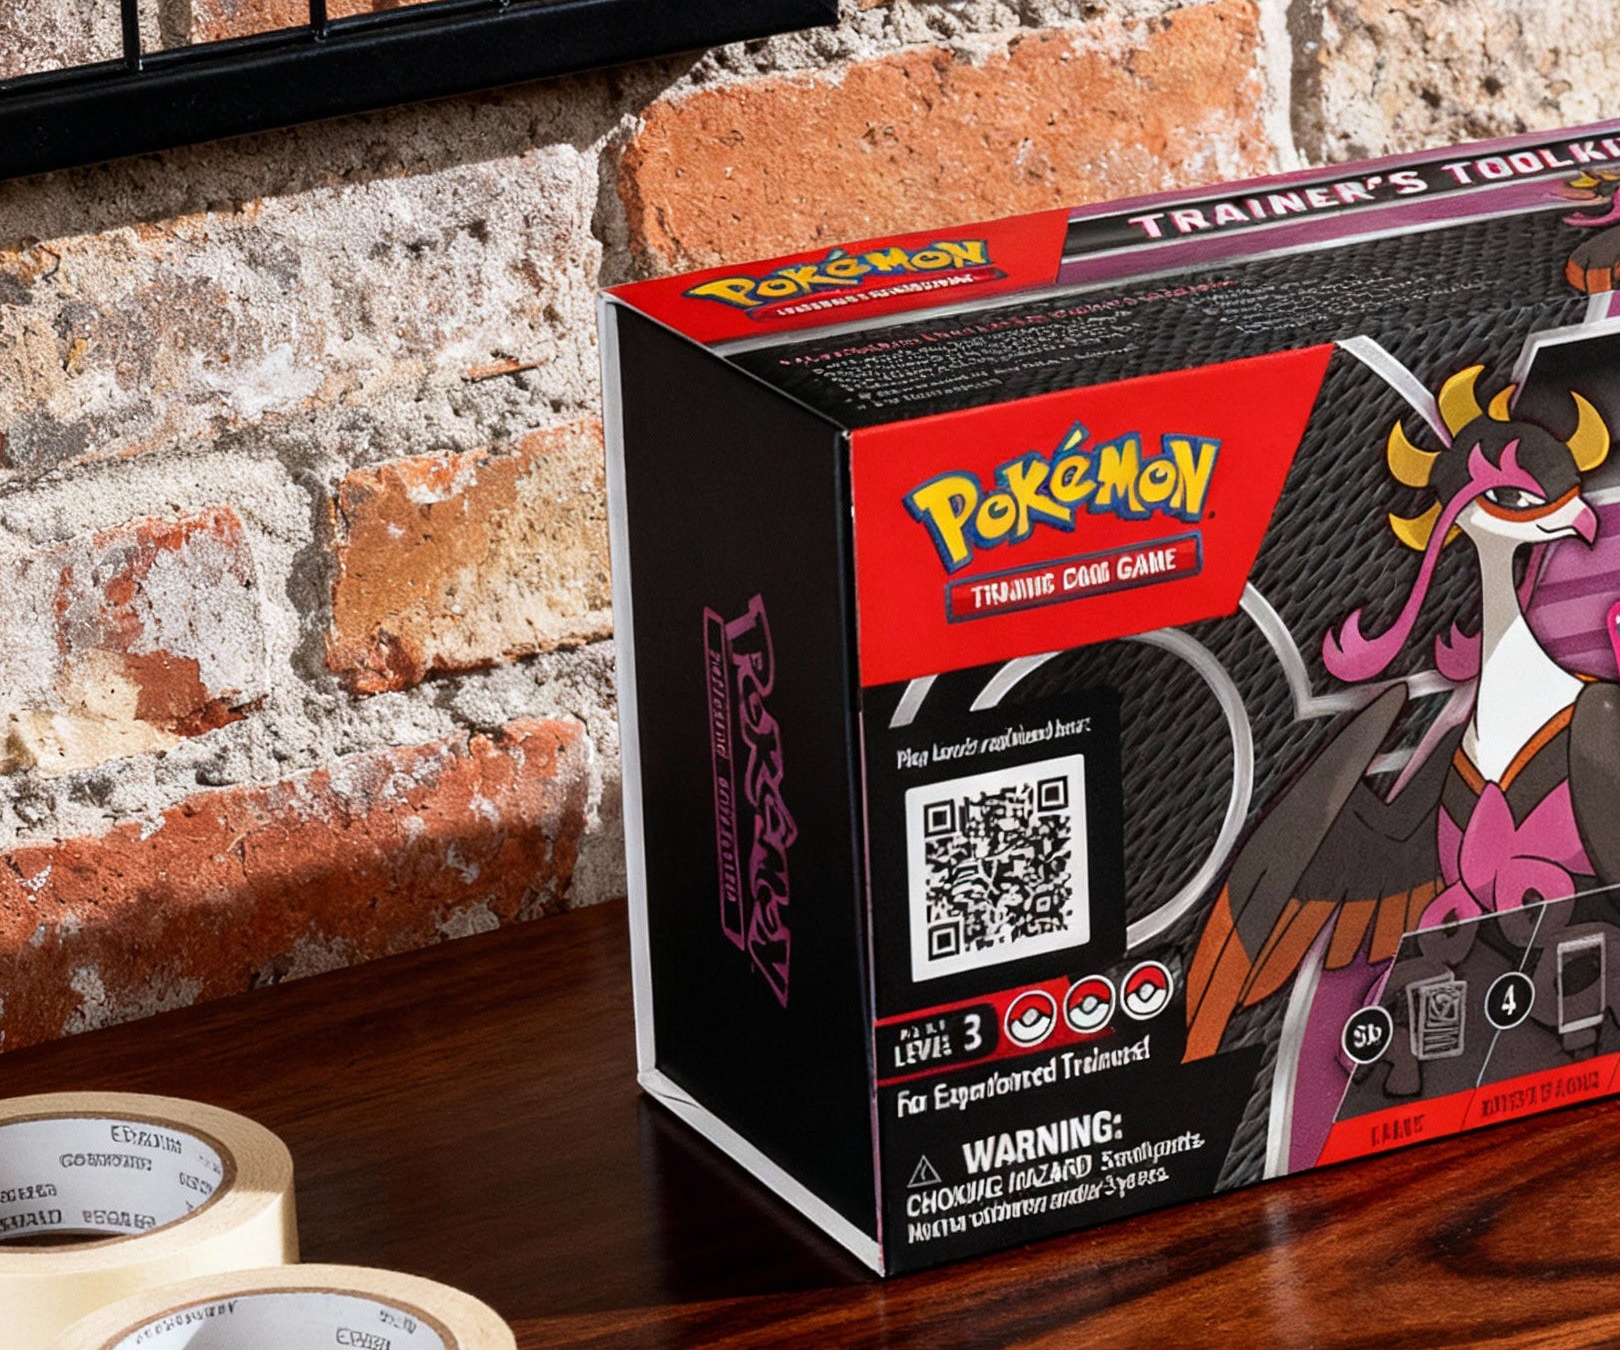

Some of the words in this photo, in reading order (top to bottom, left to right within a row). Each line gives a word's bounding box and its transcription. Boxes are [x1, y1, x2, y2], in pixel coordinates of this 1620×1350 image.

[1128, 170, 1428, 238] TRAINER'S
[1116, 547, 1177, 581] GAME
[1501, 983, 1517, 1016] 4
[963, 1013, 983, 1052] 3
[961, 1109, 1124, 1175] WARNING:
